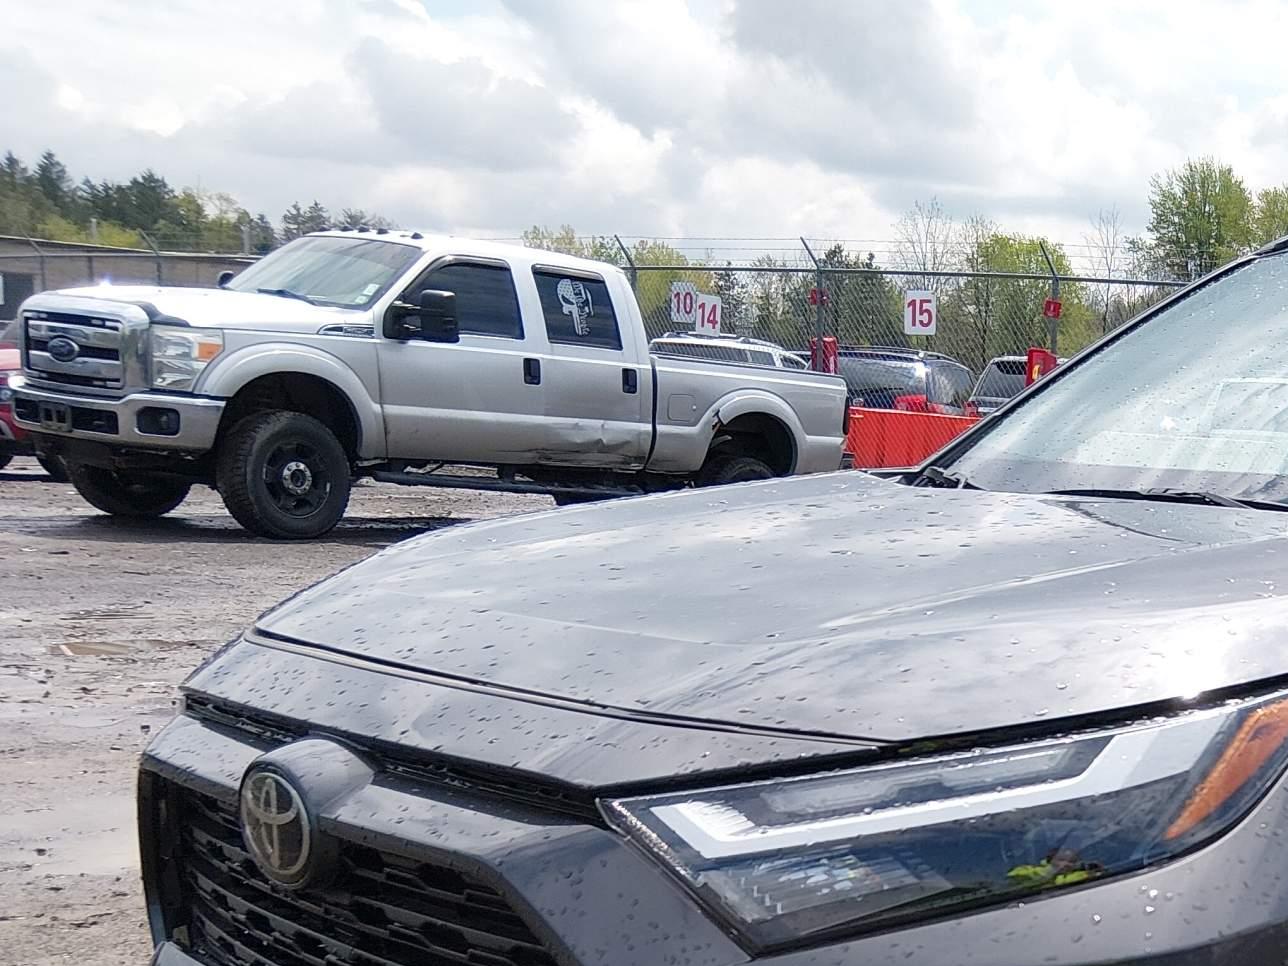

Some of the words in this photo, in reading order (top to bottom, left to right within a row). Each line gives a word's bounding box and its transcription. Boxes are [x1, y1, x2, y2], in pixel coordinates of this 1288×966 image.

[673, 291, 693, 315] 10
[698, 302, 718, 330] 14
[907, 298, 933, 328] 15
